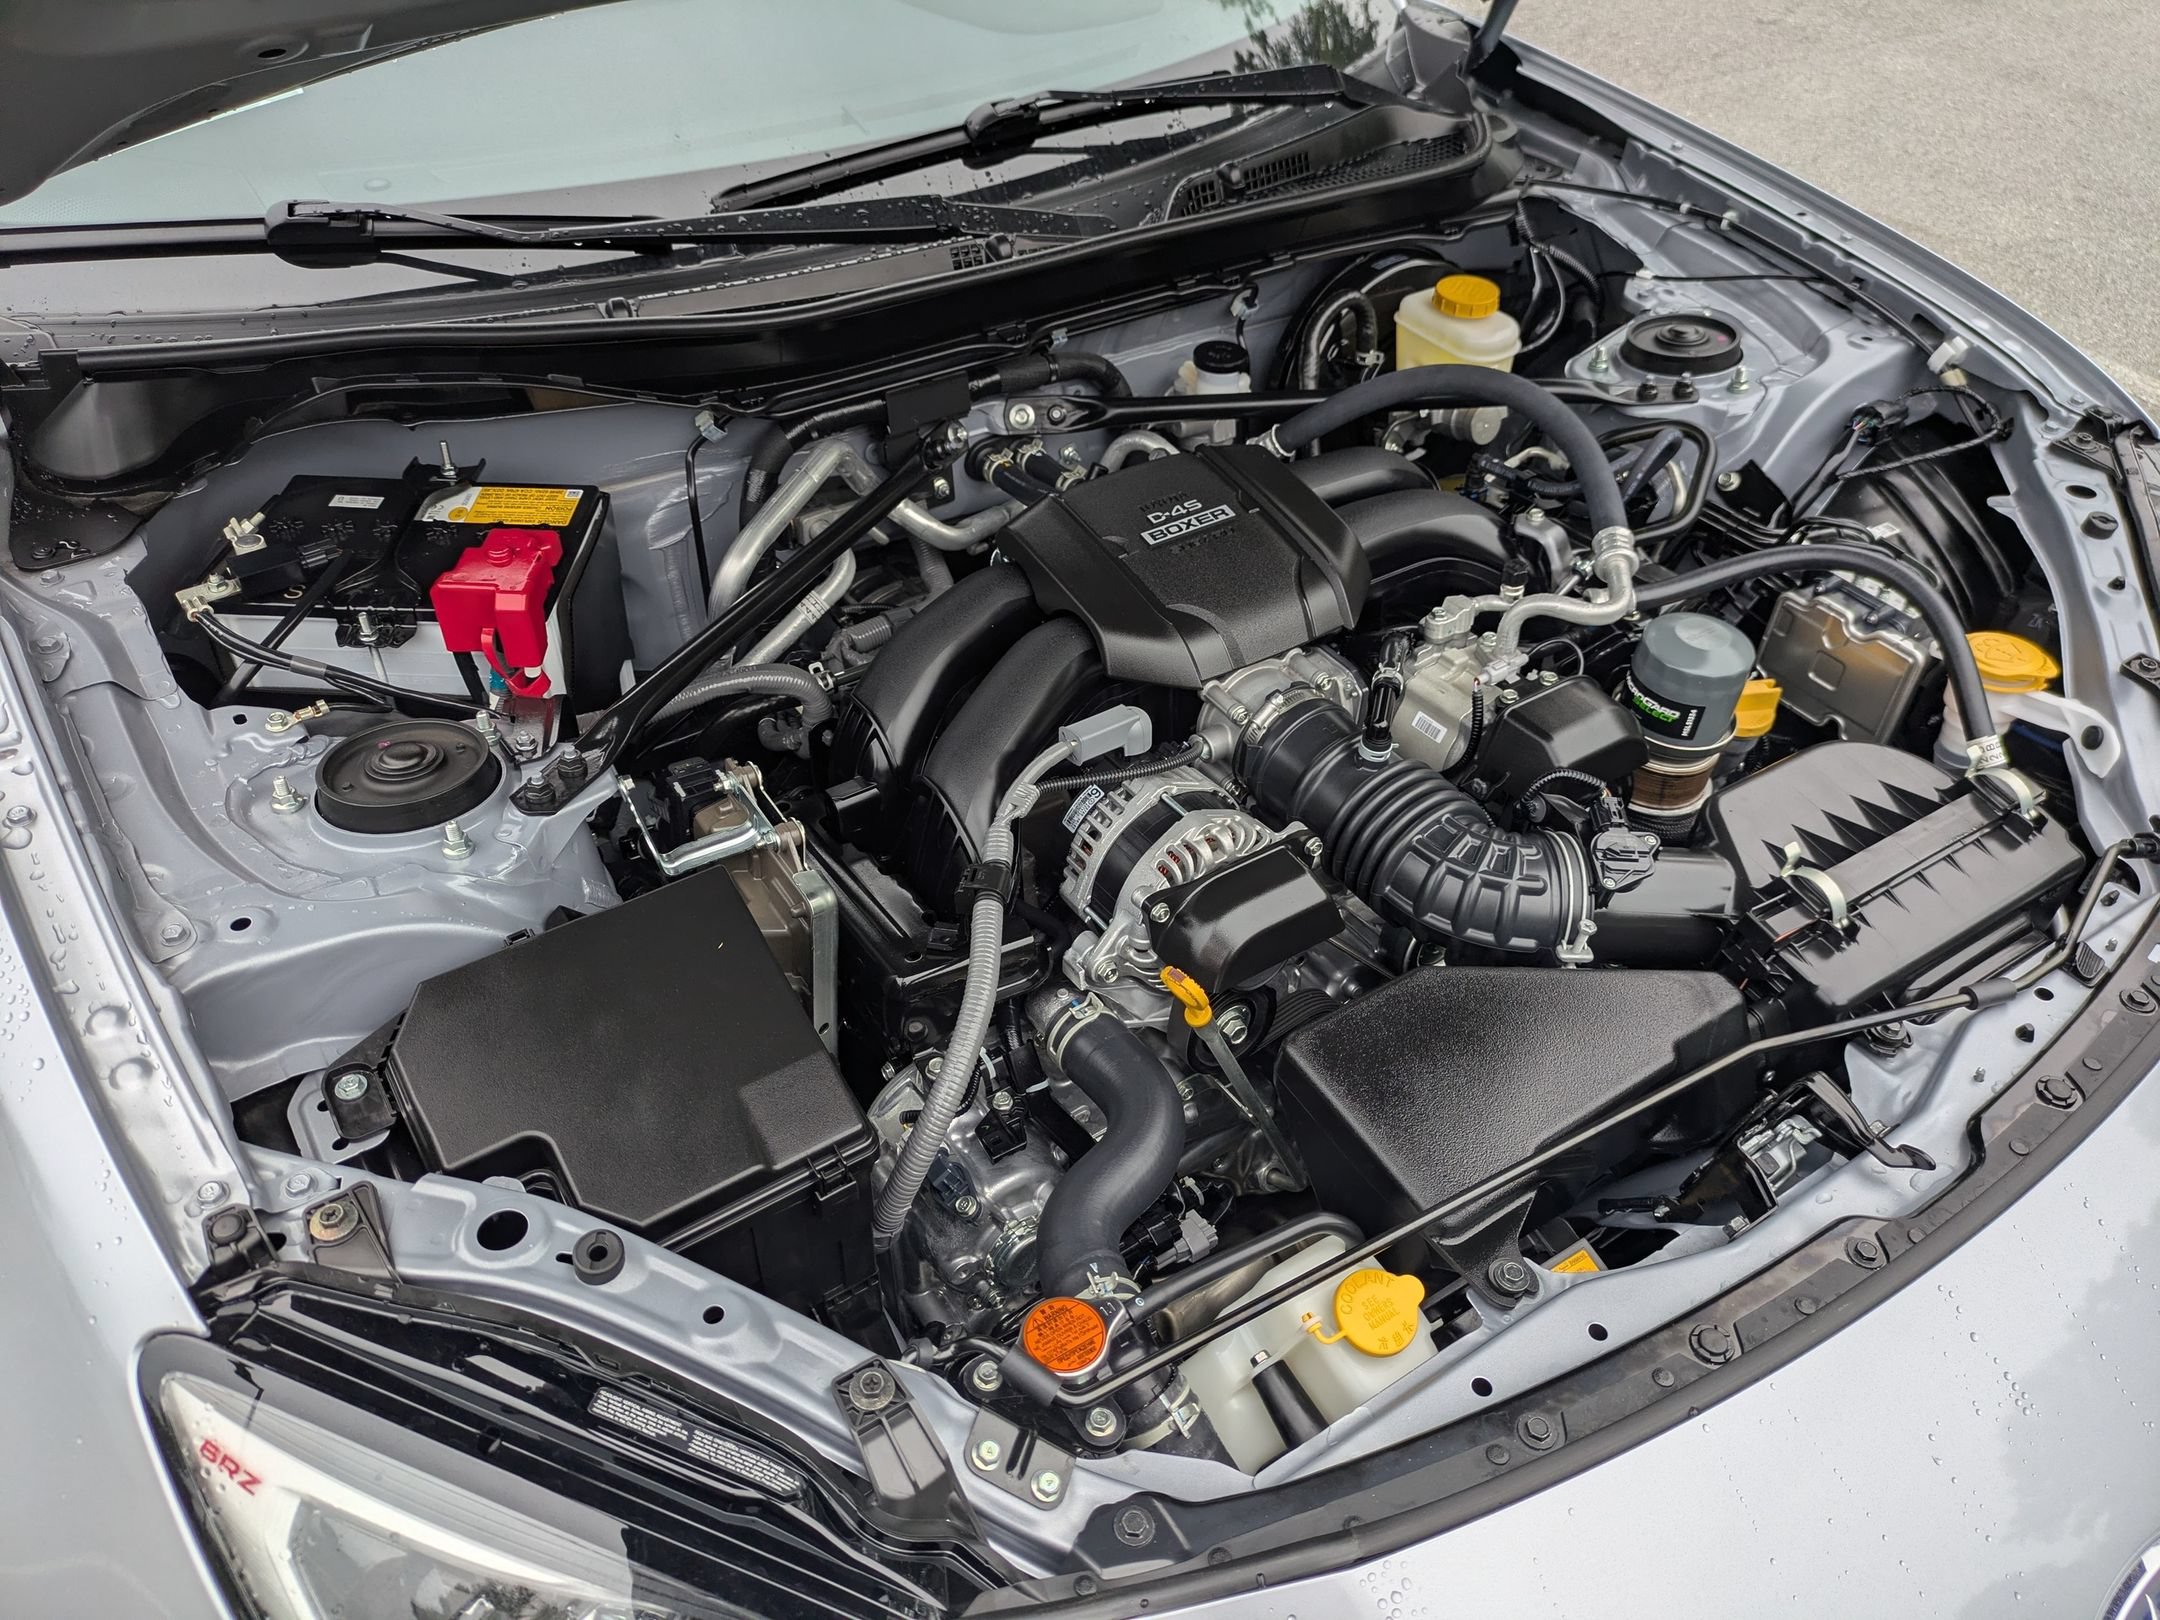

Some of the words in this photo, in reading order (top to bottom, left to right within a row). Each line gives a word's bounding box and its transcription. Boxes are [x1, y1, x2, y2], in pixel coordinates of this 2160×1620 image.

[1146, 499, 1203, 524] D-4S
[1146, 507, 1232, 542] BOXER
[1340, 1271, 1396, 1316] COOLANT
[1361, 1294, 1379, 1311] SEE
[1368, 1308, 1401, 1330] MANUAL
[199, 1438, 263, 1497] BRZ
